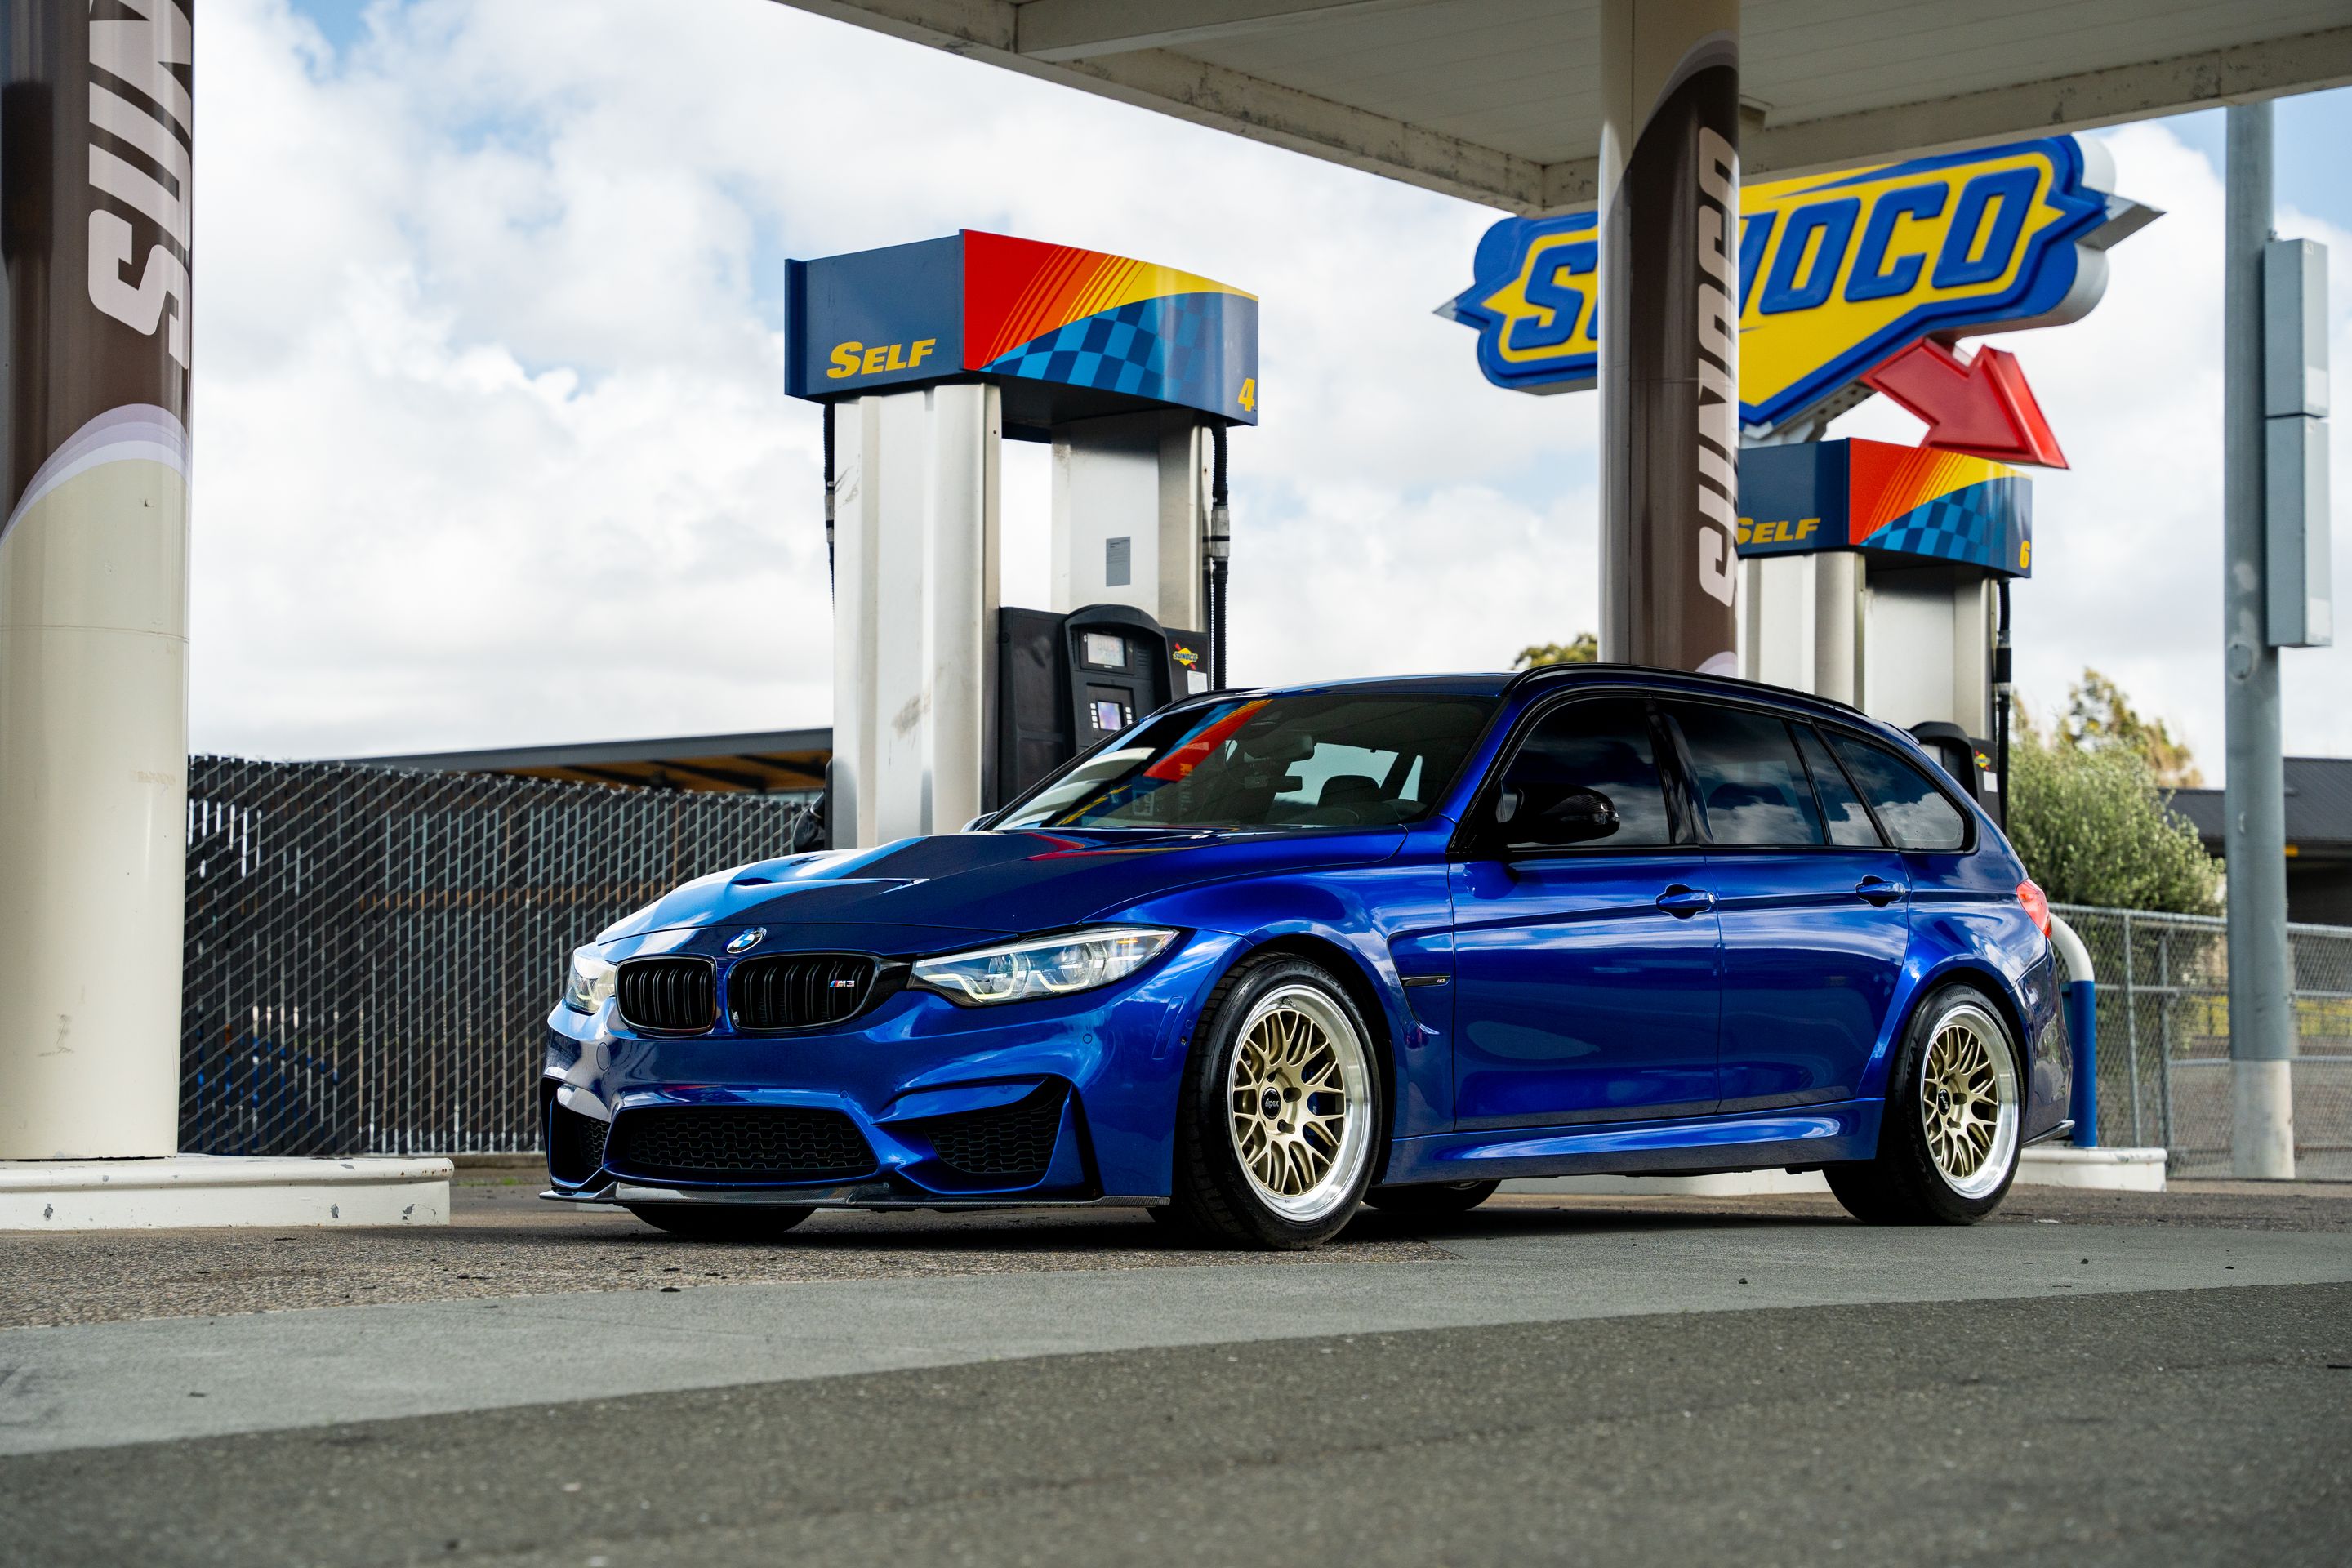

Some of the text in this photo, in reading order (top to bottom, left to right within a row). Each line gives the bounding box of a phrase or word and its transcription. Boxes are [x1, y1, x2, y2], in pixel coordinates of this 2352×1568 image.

[1508, 166, 2041, 351] SOCO
[826, 338, 936, 379] SELF
[1237, 378, 1255, 412] 4
[2020, 540, 2031, 569] 6
